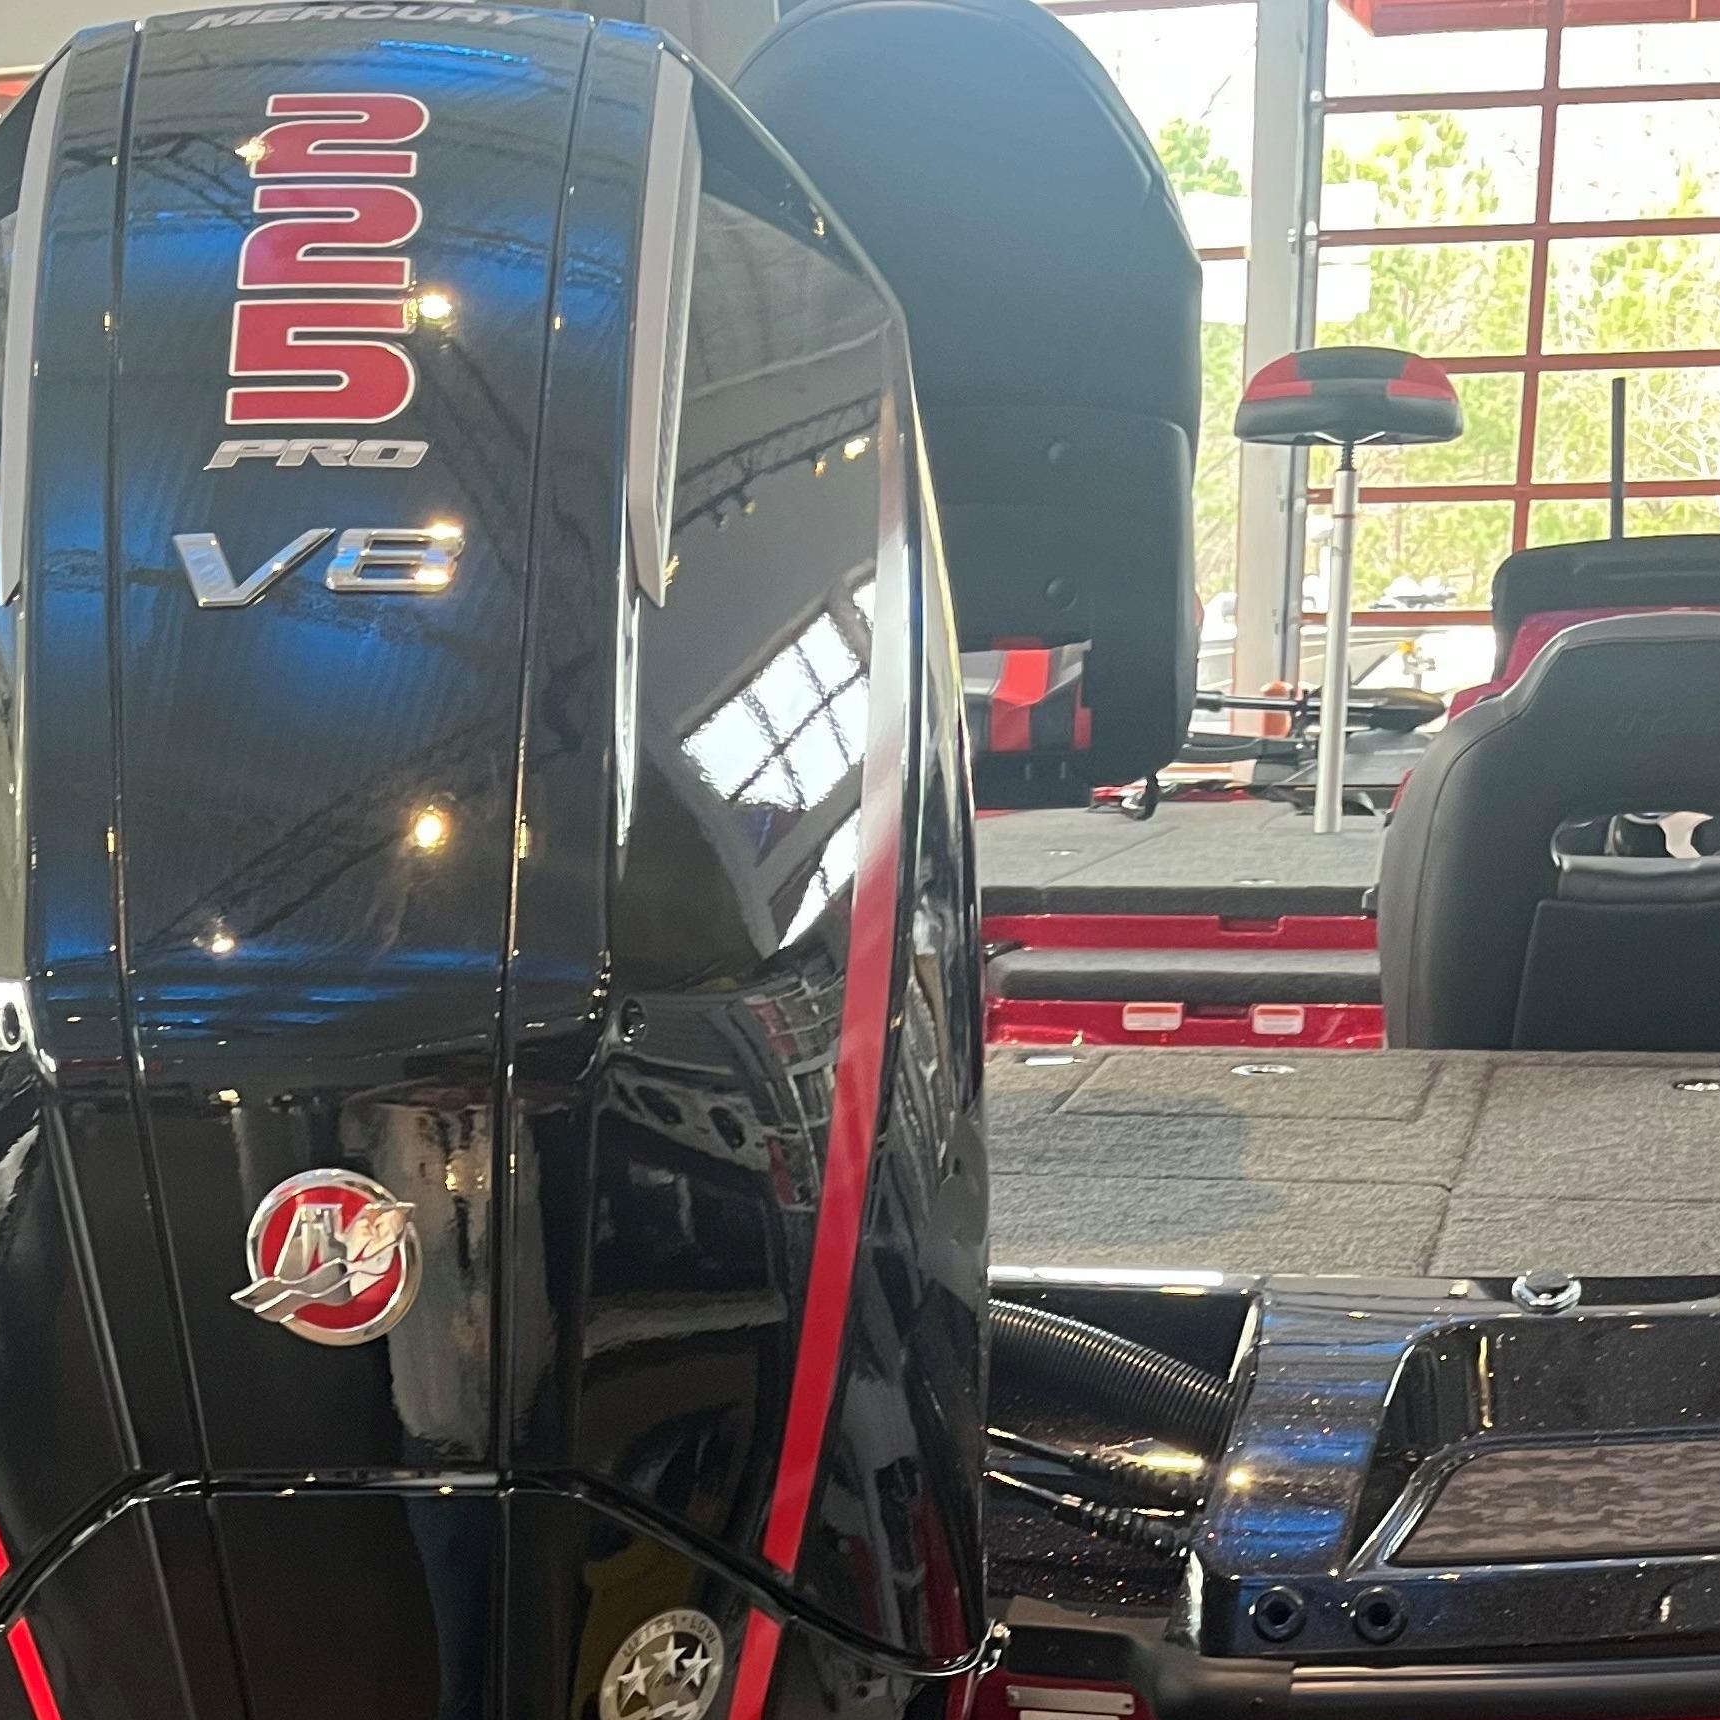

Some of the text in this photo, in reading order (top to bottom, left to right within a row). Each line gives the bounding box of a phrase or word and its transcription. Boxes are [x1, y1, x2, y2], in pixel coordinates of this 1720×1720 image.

[185, 4, 537, 32] MERCURY
[225, 93, 430, 424] 225
[204, 438, 429, 470] PRO
[173, 523, 465, 607] V8
